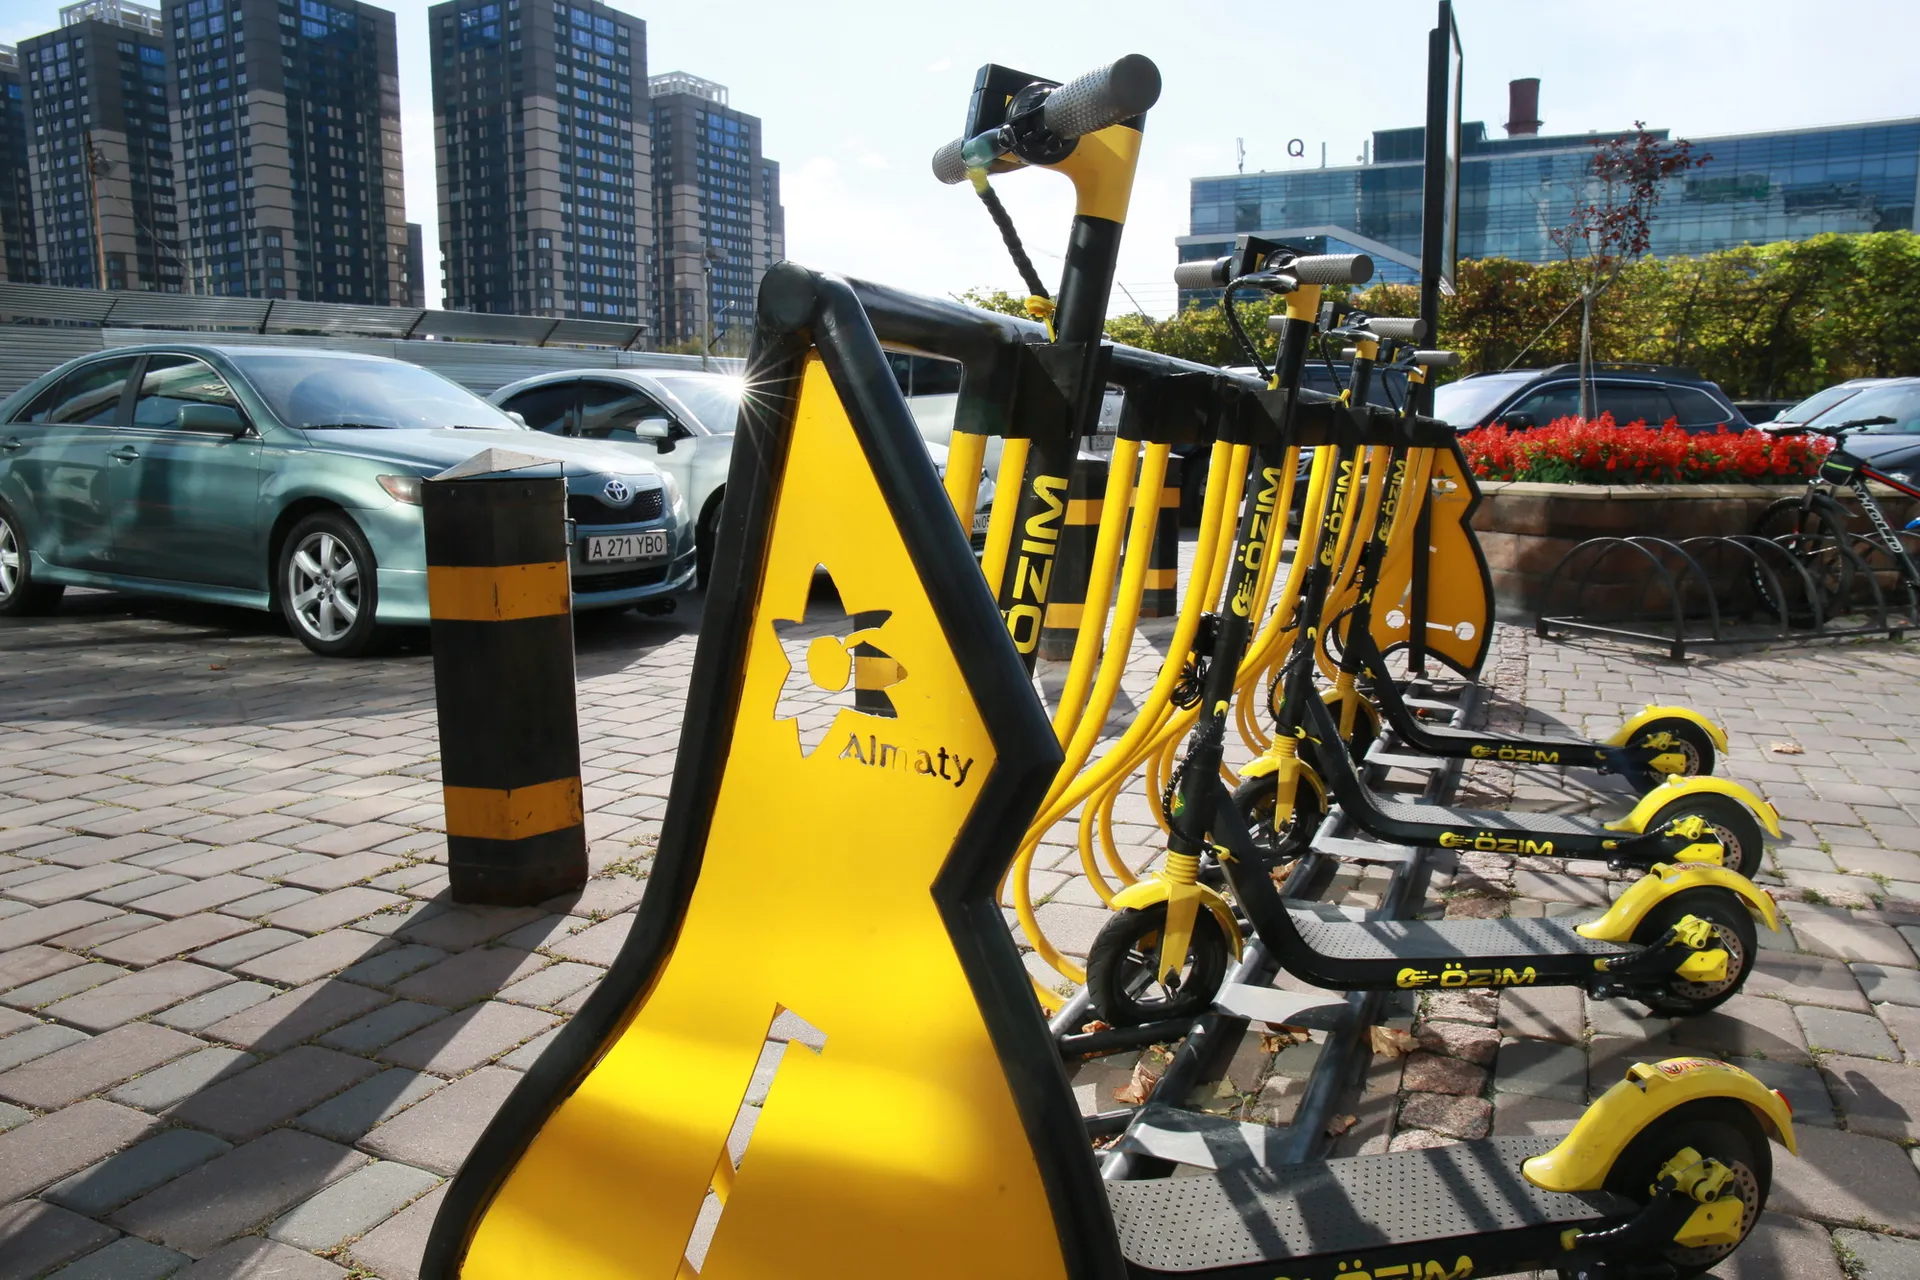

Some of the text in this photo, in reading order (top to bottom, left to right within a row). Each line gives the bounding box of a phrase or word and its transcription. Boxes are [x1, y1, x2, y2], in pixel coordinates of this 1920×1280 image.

[1286, 138, 1304, 158] Q
[593, 540, 602, 558] A
[607, 537, 631, 557] 271
[839, 732, 974, 788] Almaty
